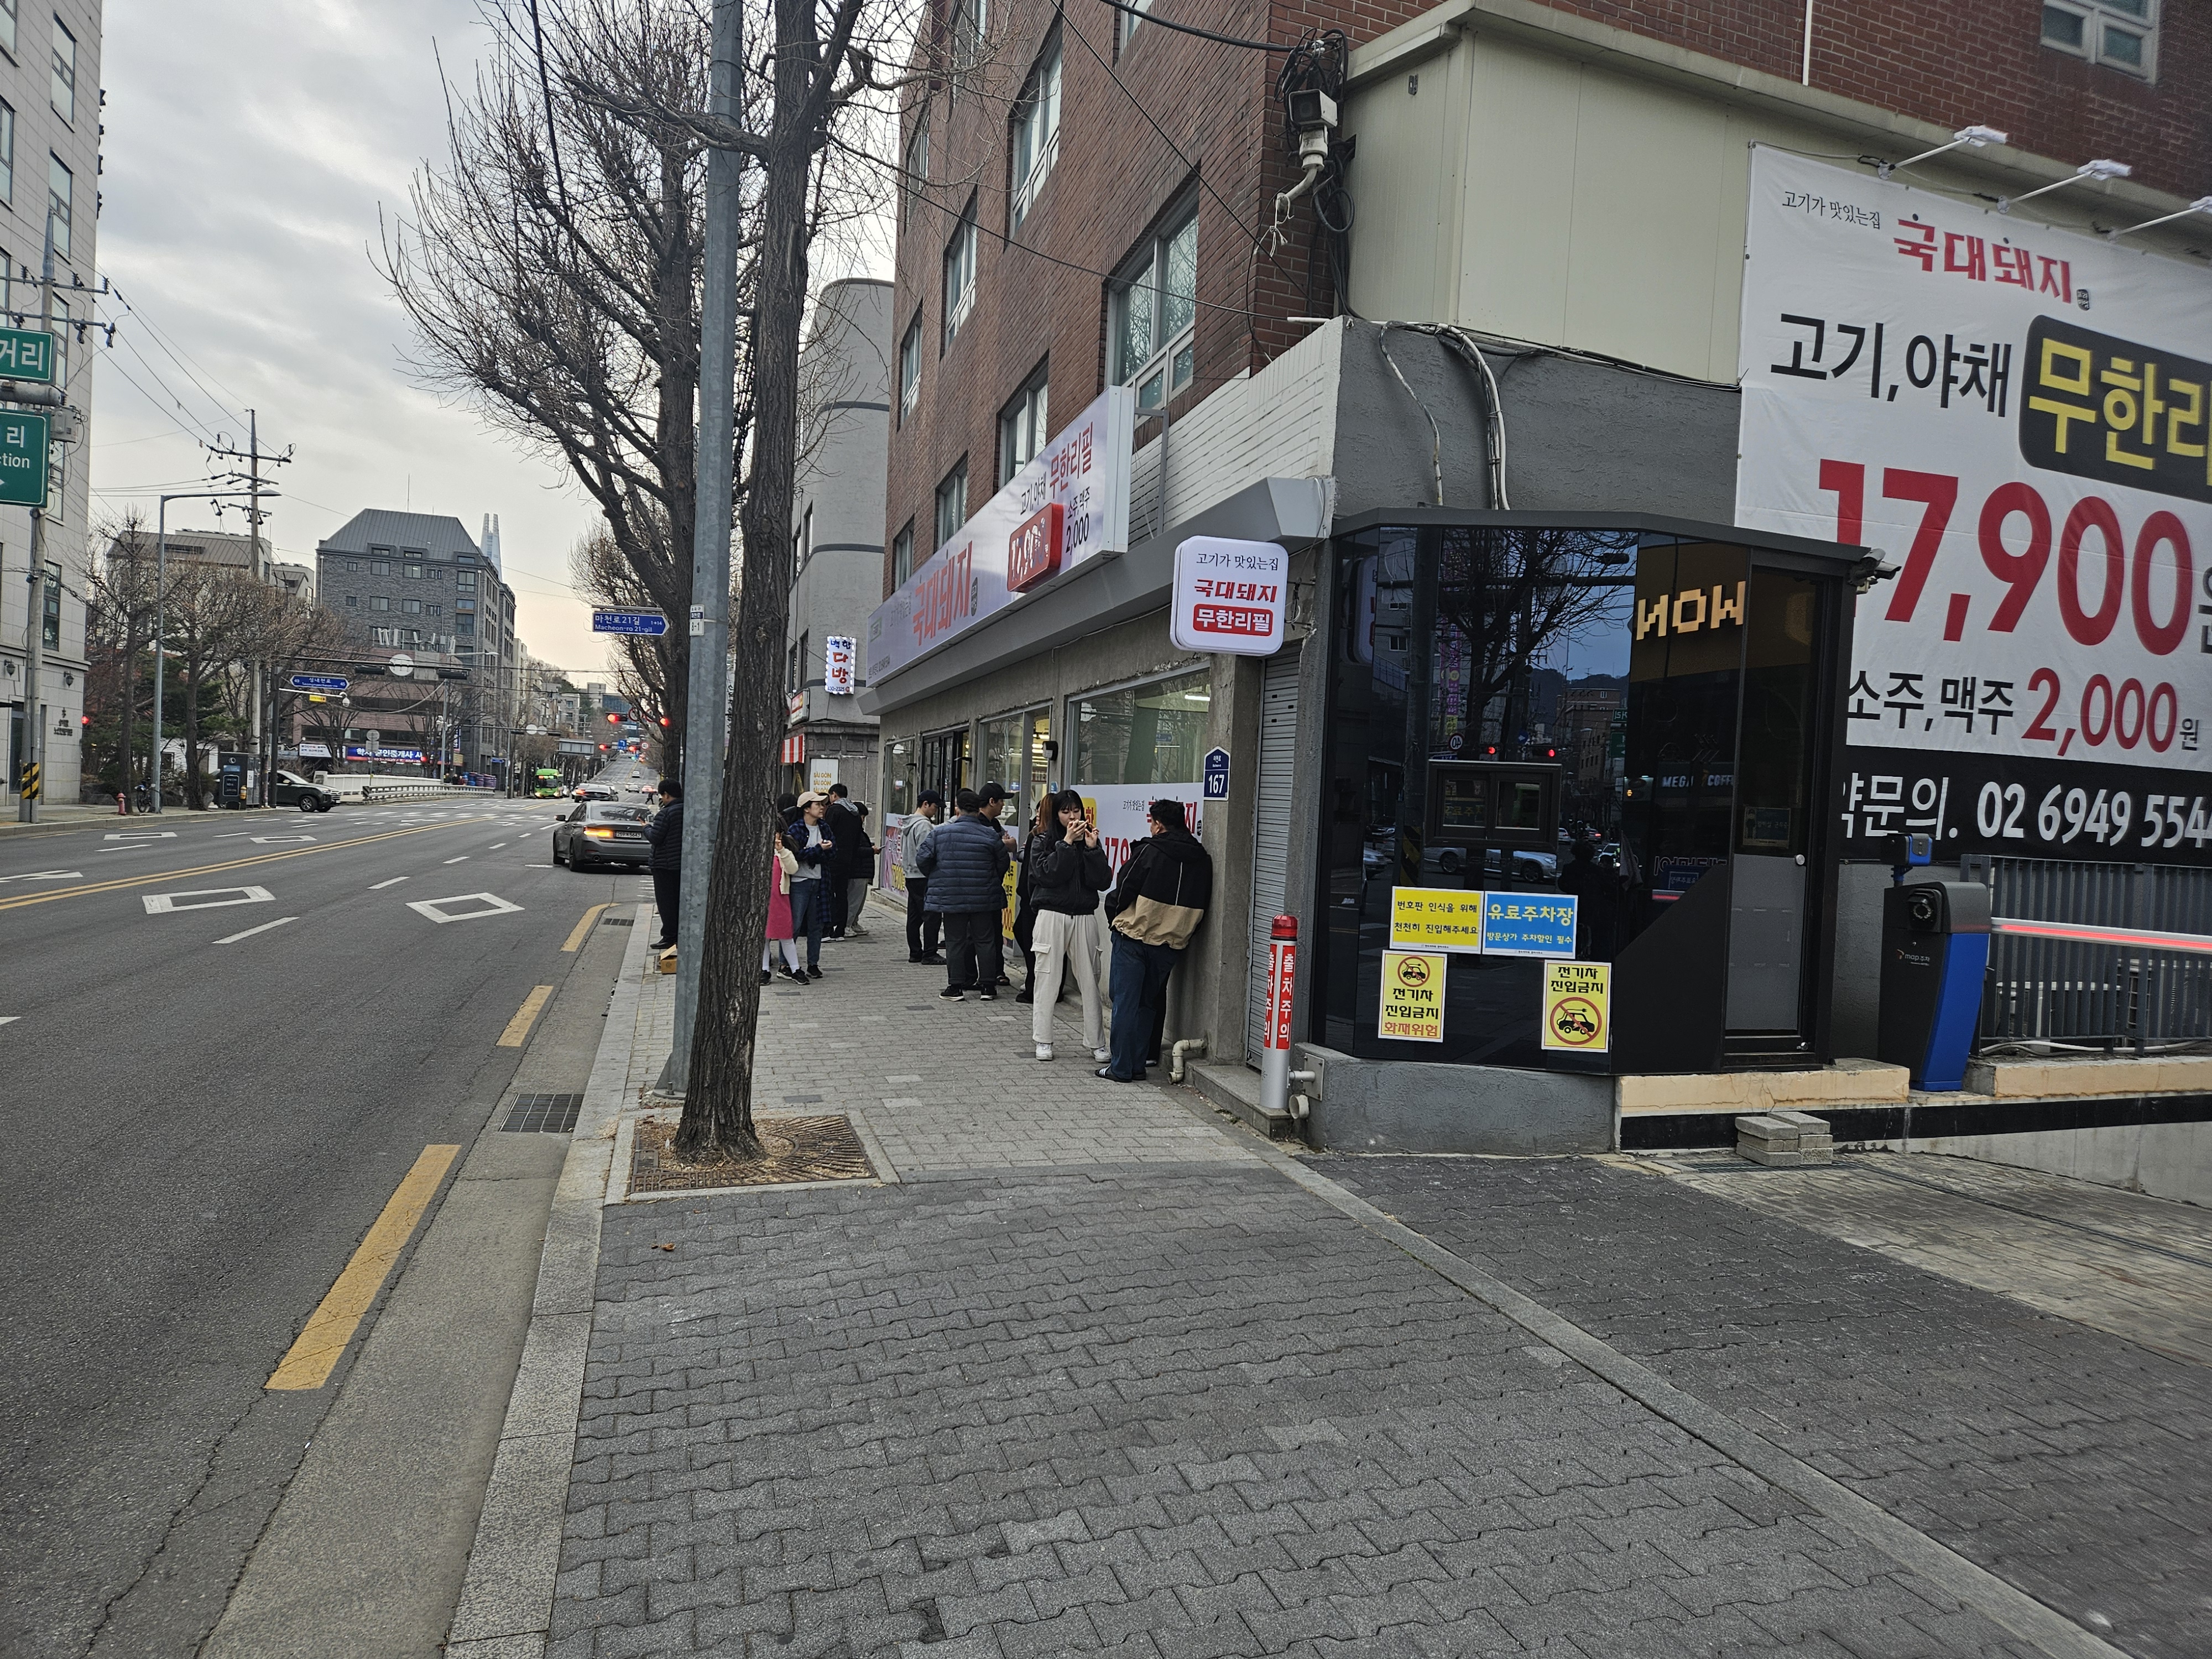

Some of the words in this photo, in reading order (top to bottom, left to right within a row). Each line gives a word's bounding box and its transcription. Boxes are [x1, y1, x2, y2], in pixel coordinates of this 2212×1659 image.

[1782, 191, 1826, 217] 고기가
[1830, 201, 1881, 230] 맛있는집
[1893, 218, 2071, 304] 국대돼지
[1771, 313, 2012, 418] 고기,야채
[7, 425, 24, 448] 리
[0, 452, 30, 468] tion
[1020, 471, 1047, 515] 고기,야채
[1049, 421, 1093, 499] 무한리필
[1067, 486, 1090, 520] 소주,맥주
[1066, 512, 1089, 556] 2,000
[1196, 553, 1231, 567] 고기가
[1235, 555, 1278, 570] 맛있는집
[1819, 458, 2193, 655] 17,900
[913, 540, 973, 646] 국대돼지
[1194, 579, 1277, 602] 국대돼지
[595, 614, 640, 625] 마천로21길
[1197, 608, 1270, 632] 무한리필
[832, 652, 848, 684] 다방
[1847, 670, 2013, 735] 소주,맥주
[2021, 667, 2177, 757] 2,000
[2179, 718, 2199, 751] 원
[374, 749, 413, 759] 공인중개사
[1208, 774, 1225, 794] 167
[1977, 781, 2026, 838] 02
[2038, 784, 2131, 846] 6949
[1397, 901, 1423, 911] 번호판
[1428, 902, 1454, 912] 인식을
[1460, 904, 1477, 912] 위해
[1488, 904, 1574, 926] 유료주차장
[1394, 922, 1420, 932] 천천히
[1426, 924, 1479, 935] 진입해주세요
[1487, 932, 1517, 942] 방문상가
[1522, 933, 1552, 943] 주차할인
[1557, 935, 1572, 944] 필수
[1557, 966, 1598, 980] 전기차
[1279, 953, 1294, 1042] 출차주의
[1392, 988, 1433, 1002] 전기차
[1550, 980, 1604, 994] 진입금지
[1385, 1005, 1438, 1020] 진입금지
[1384, 1021, 1438, 1037] 화재위험
